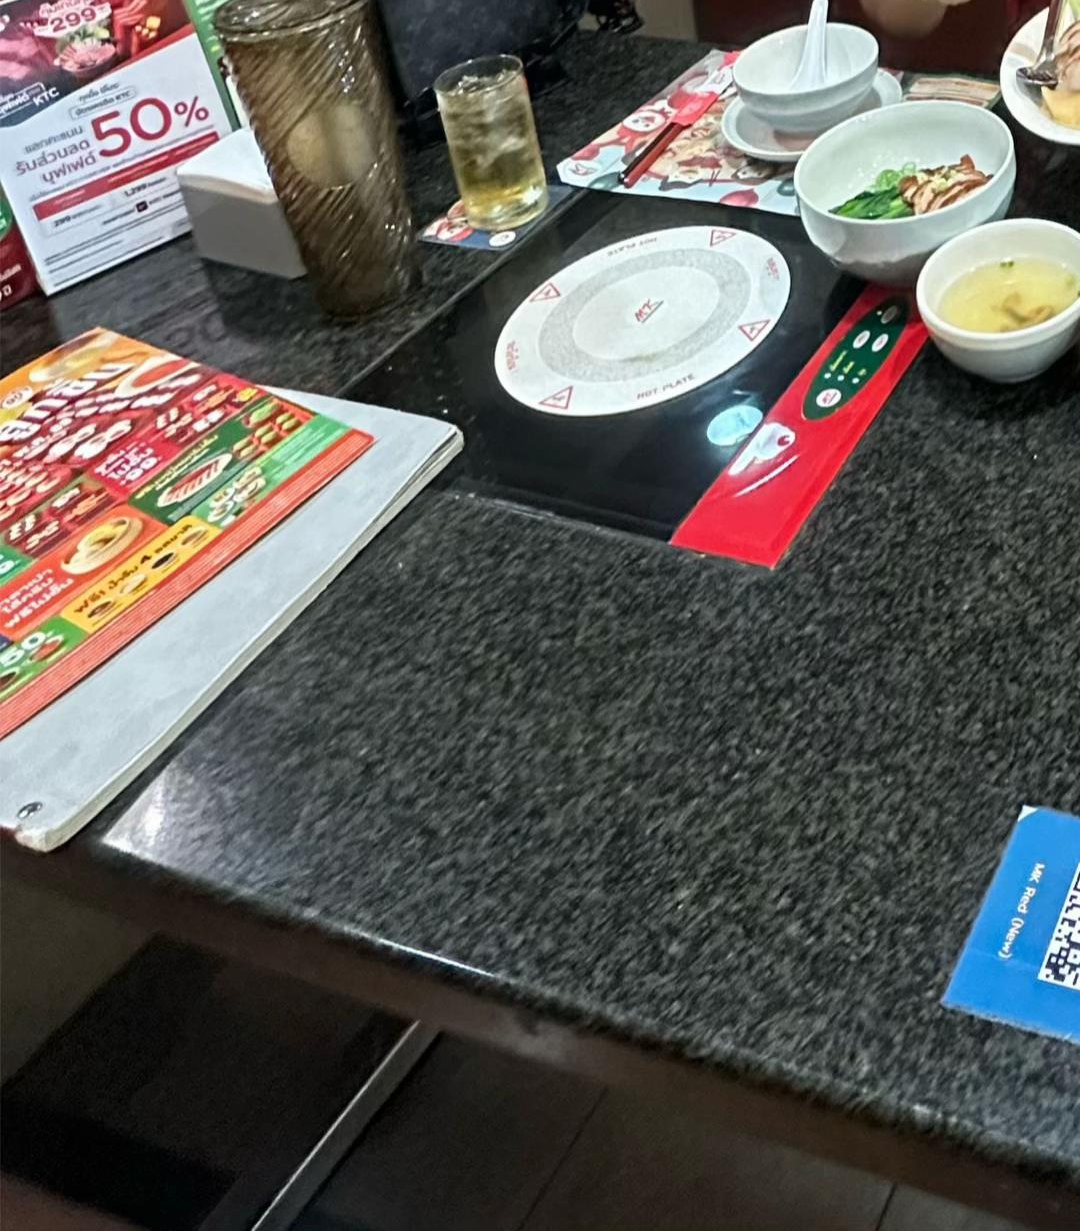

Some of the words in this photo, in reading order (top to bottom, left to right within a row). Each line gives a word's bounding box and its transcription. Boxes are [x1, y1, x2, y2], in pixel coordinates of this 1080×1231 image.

[50, 8, 97, 34] 299
[33, 88, 60, 107] KTC
[15, 139, 91, 175] รับส่วนลด
[42, 153, 97, 185] บุฟเฟต์
[636, 386, 660, 400] HOT
[661, 372, 696, 394] PLATE
[139, 554, 152, 565] 4
[1029, 862, 1046, 885] MK
[1017, 885, 1036, 915] Red
[998, 916, 1025, 961] (New)
